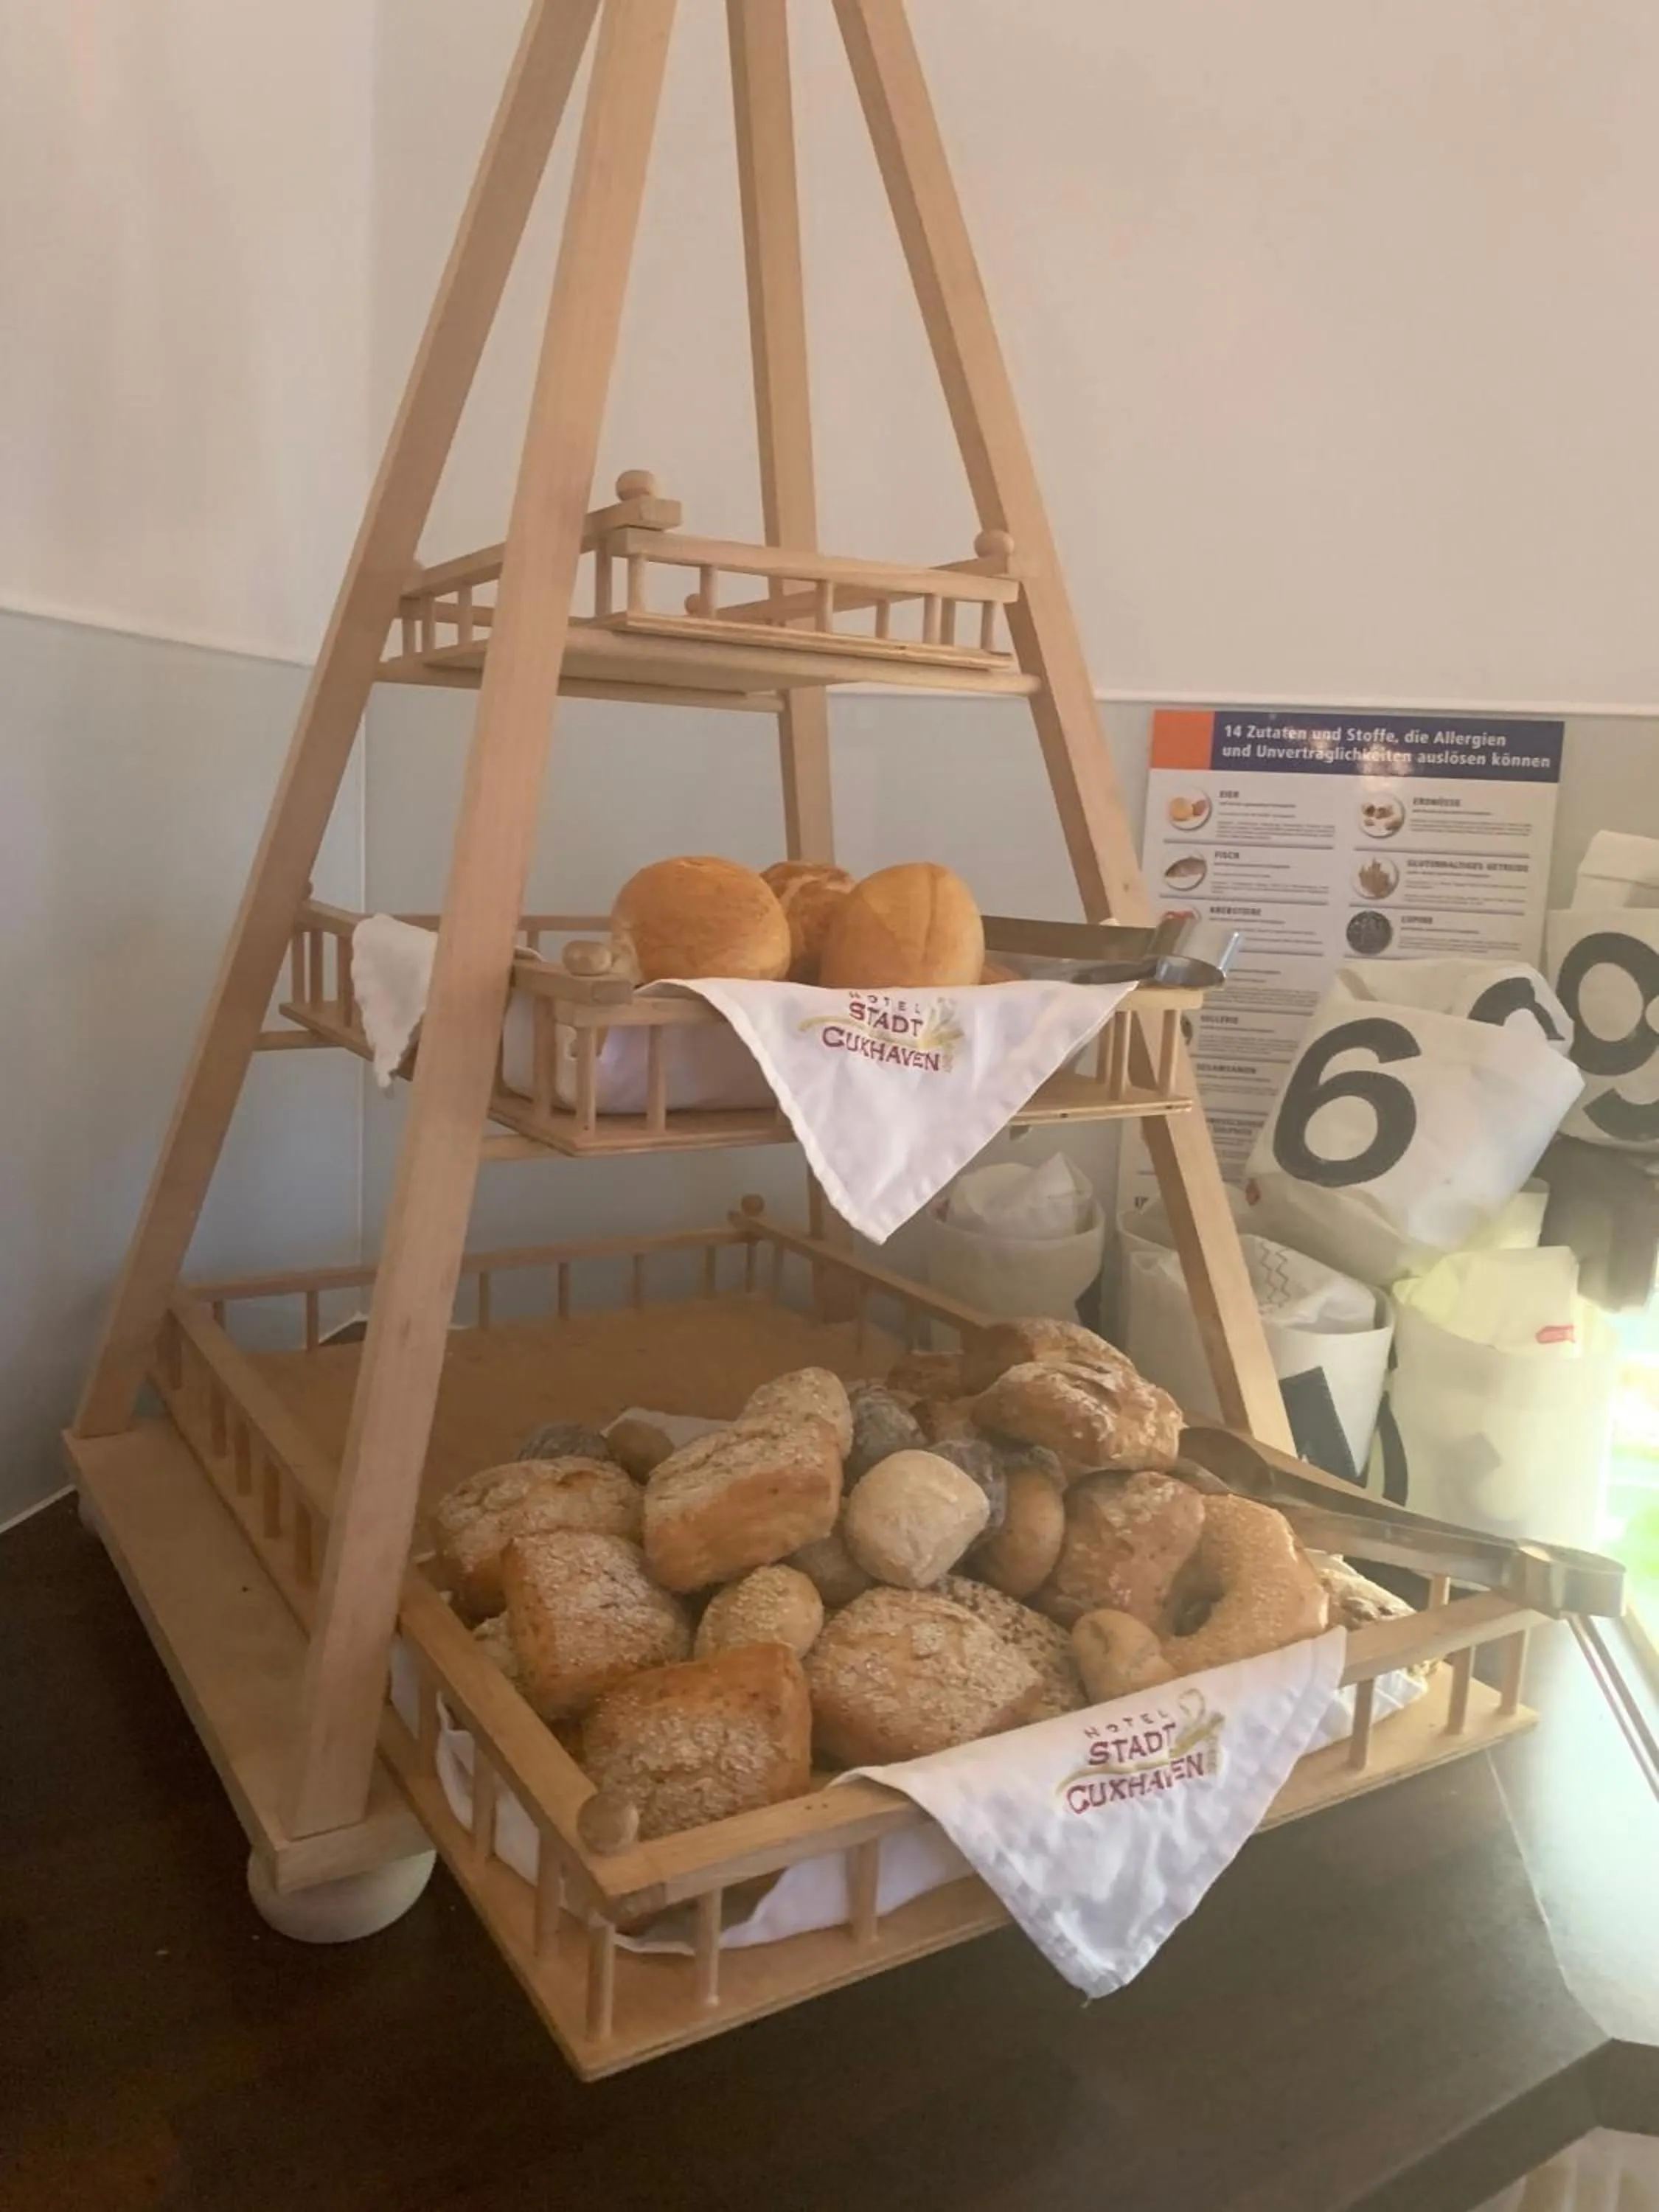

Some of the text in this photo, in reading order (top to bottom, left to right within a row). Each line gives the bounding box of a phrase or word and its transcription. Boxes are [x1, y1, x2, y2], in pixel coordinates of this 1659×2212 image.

[1224, 725, 1506, 749] 14 Zutaten und Stoffe, die Allergien
[1222, 744, 1251, 757] und
[1417, 750, 1486, 765] auslösen
[1492, 752, 1551, 768] können
[849, 1002, 924, 1037] STADT
[1272, 1017, 1422, 1187] 6
[1083, 1710, 1169, 1738] HOTEL
[1088, 1722, 1177, 1766] STADT
